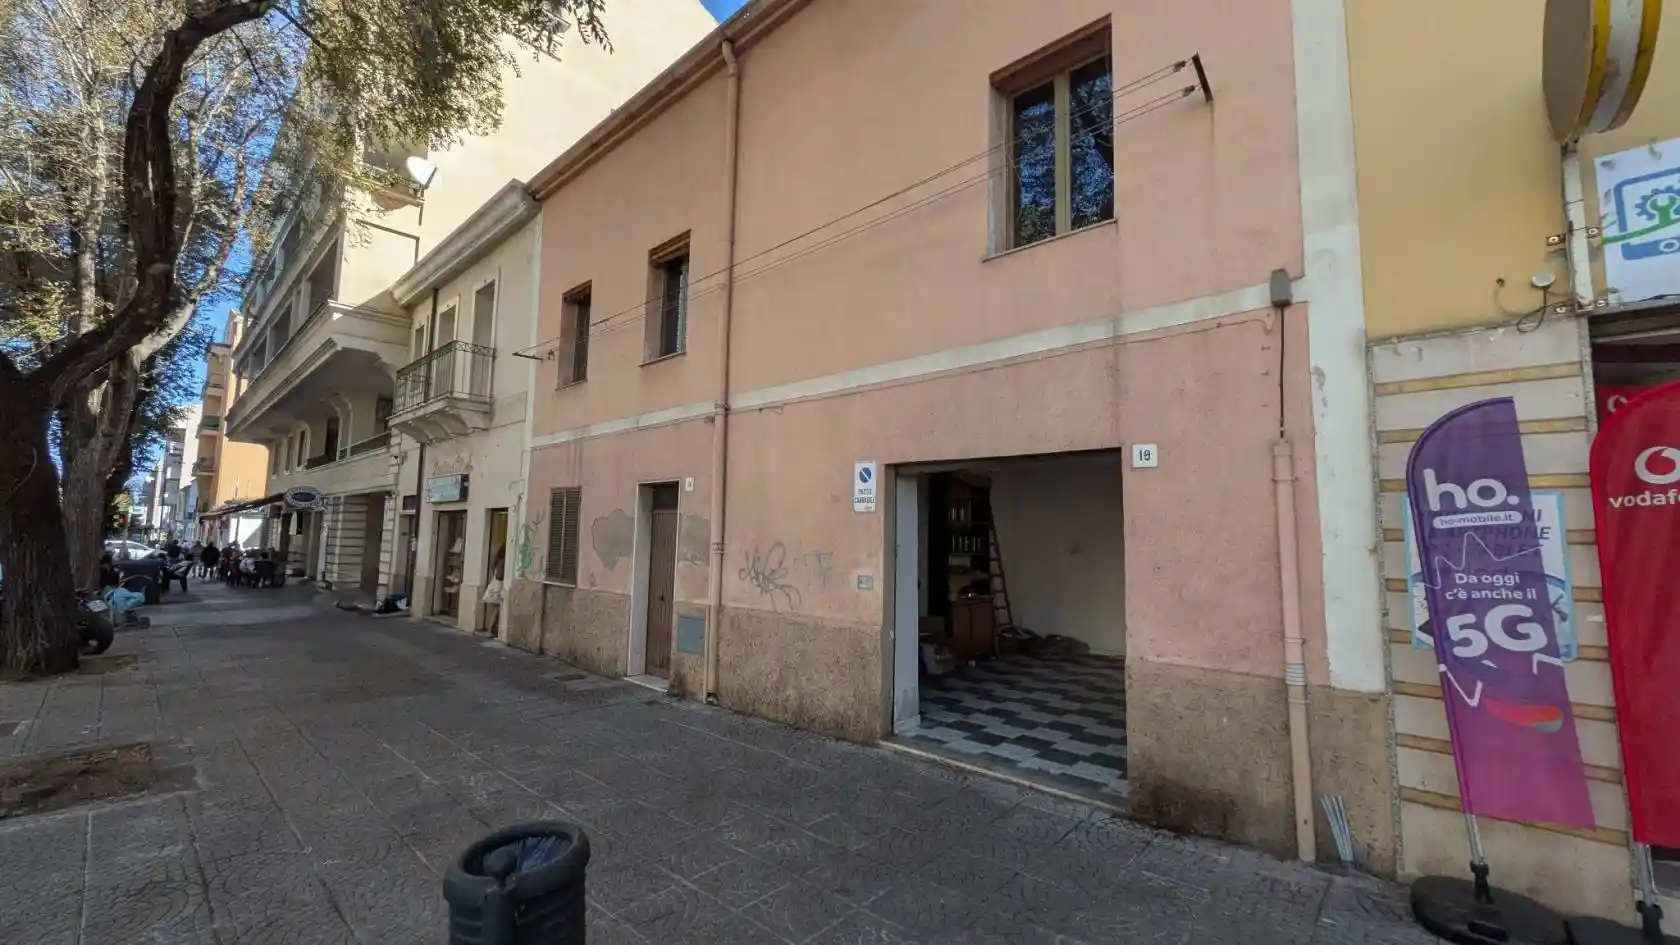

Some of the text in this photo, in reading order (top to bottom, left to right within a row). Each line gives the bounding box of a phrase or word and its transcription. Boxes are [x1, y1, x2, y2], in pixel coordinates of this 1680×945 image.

[1422, 468, 1520, 512] ho.
[1609, 490, 1680, 508] vodaf
[1439, 512, 1516, 527] ho-mobile.it
[1454, 572, 1520, 586] Da oggi
[1445, 587, 1537, 600] c'è anche il
[1446, 603, 1548, 658] 5G
